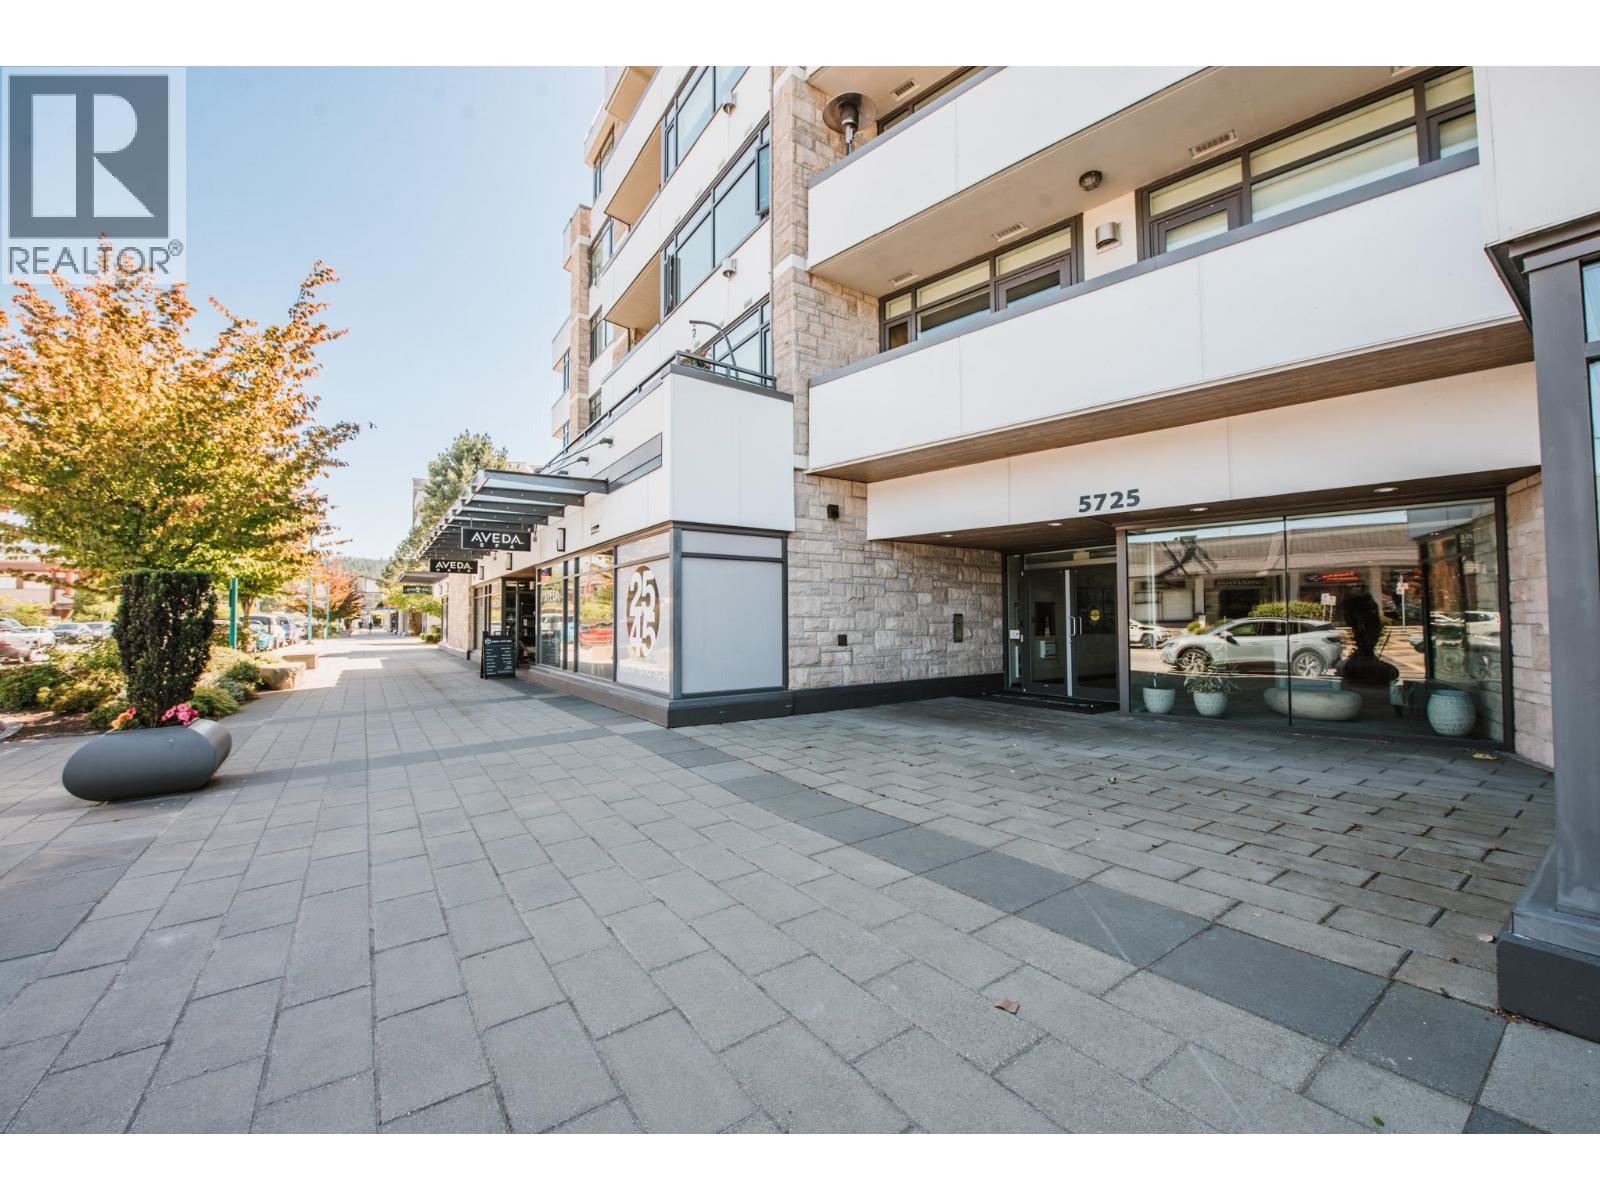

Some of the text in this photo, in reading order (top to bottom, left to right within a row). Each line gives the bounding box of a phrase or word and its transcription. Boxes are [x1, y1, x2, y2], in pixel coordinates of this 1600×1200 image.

[1078, 488, 1141, 513] 5725
[471, 531, 523, 545] AVEDA
[479, 542, 515, 550] SPA
[435, 560, 473, 570] AVEDA
[629, 569, 657, 617] 25
[629, 605, 657, 658] 45
